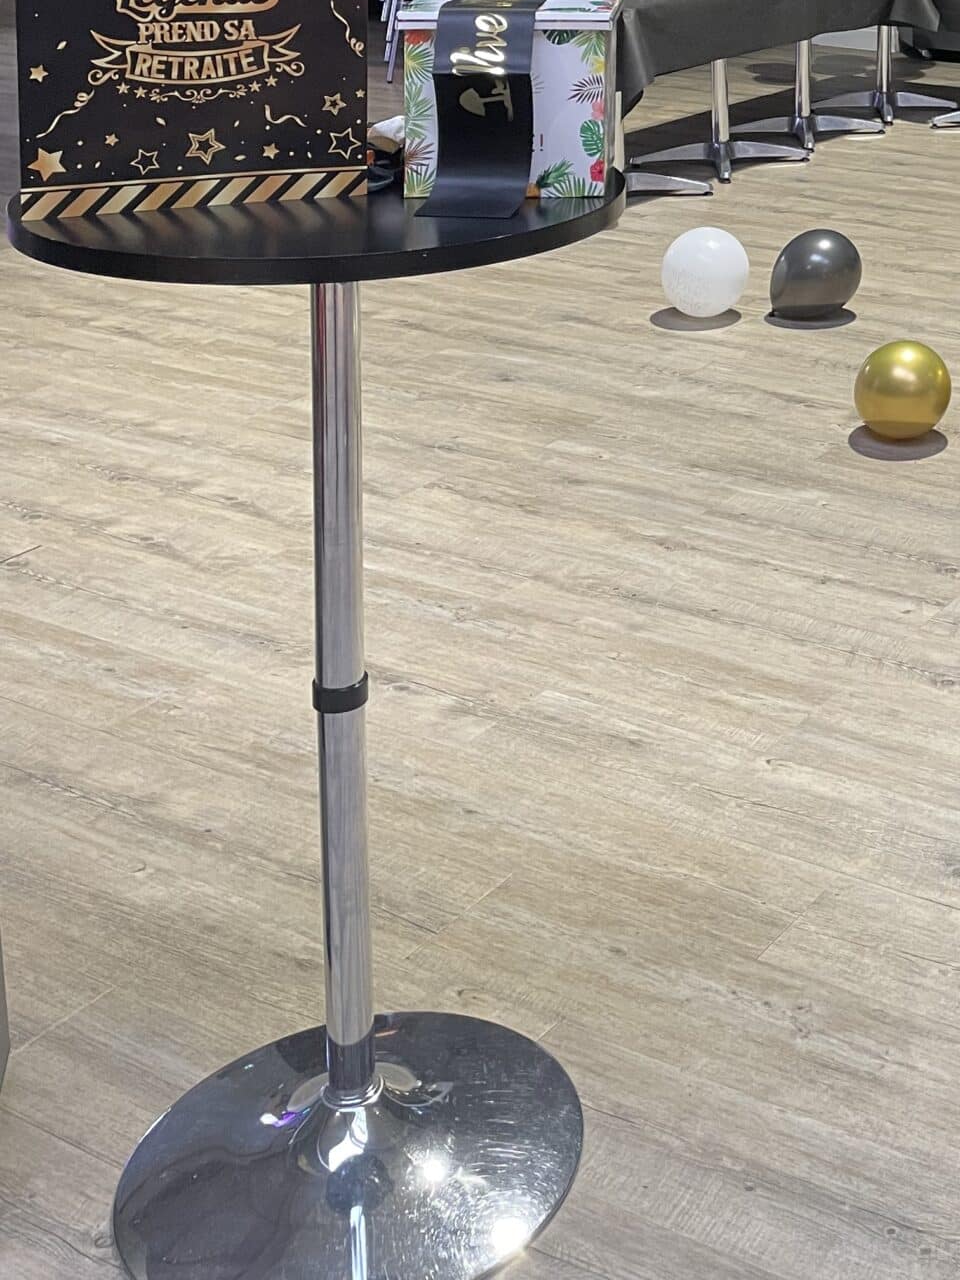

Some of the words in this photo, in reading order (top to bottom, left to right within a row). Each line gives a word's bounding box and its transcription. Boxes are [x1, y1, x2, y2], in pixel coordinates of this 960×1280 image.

[137, 21, 221, 44] PREND
[224, 20, 258, 41] SA
[450, 12, 508, 76] Vive
[134, 48, 259, 80] RETRAITE
